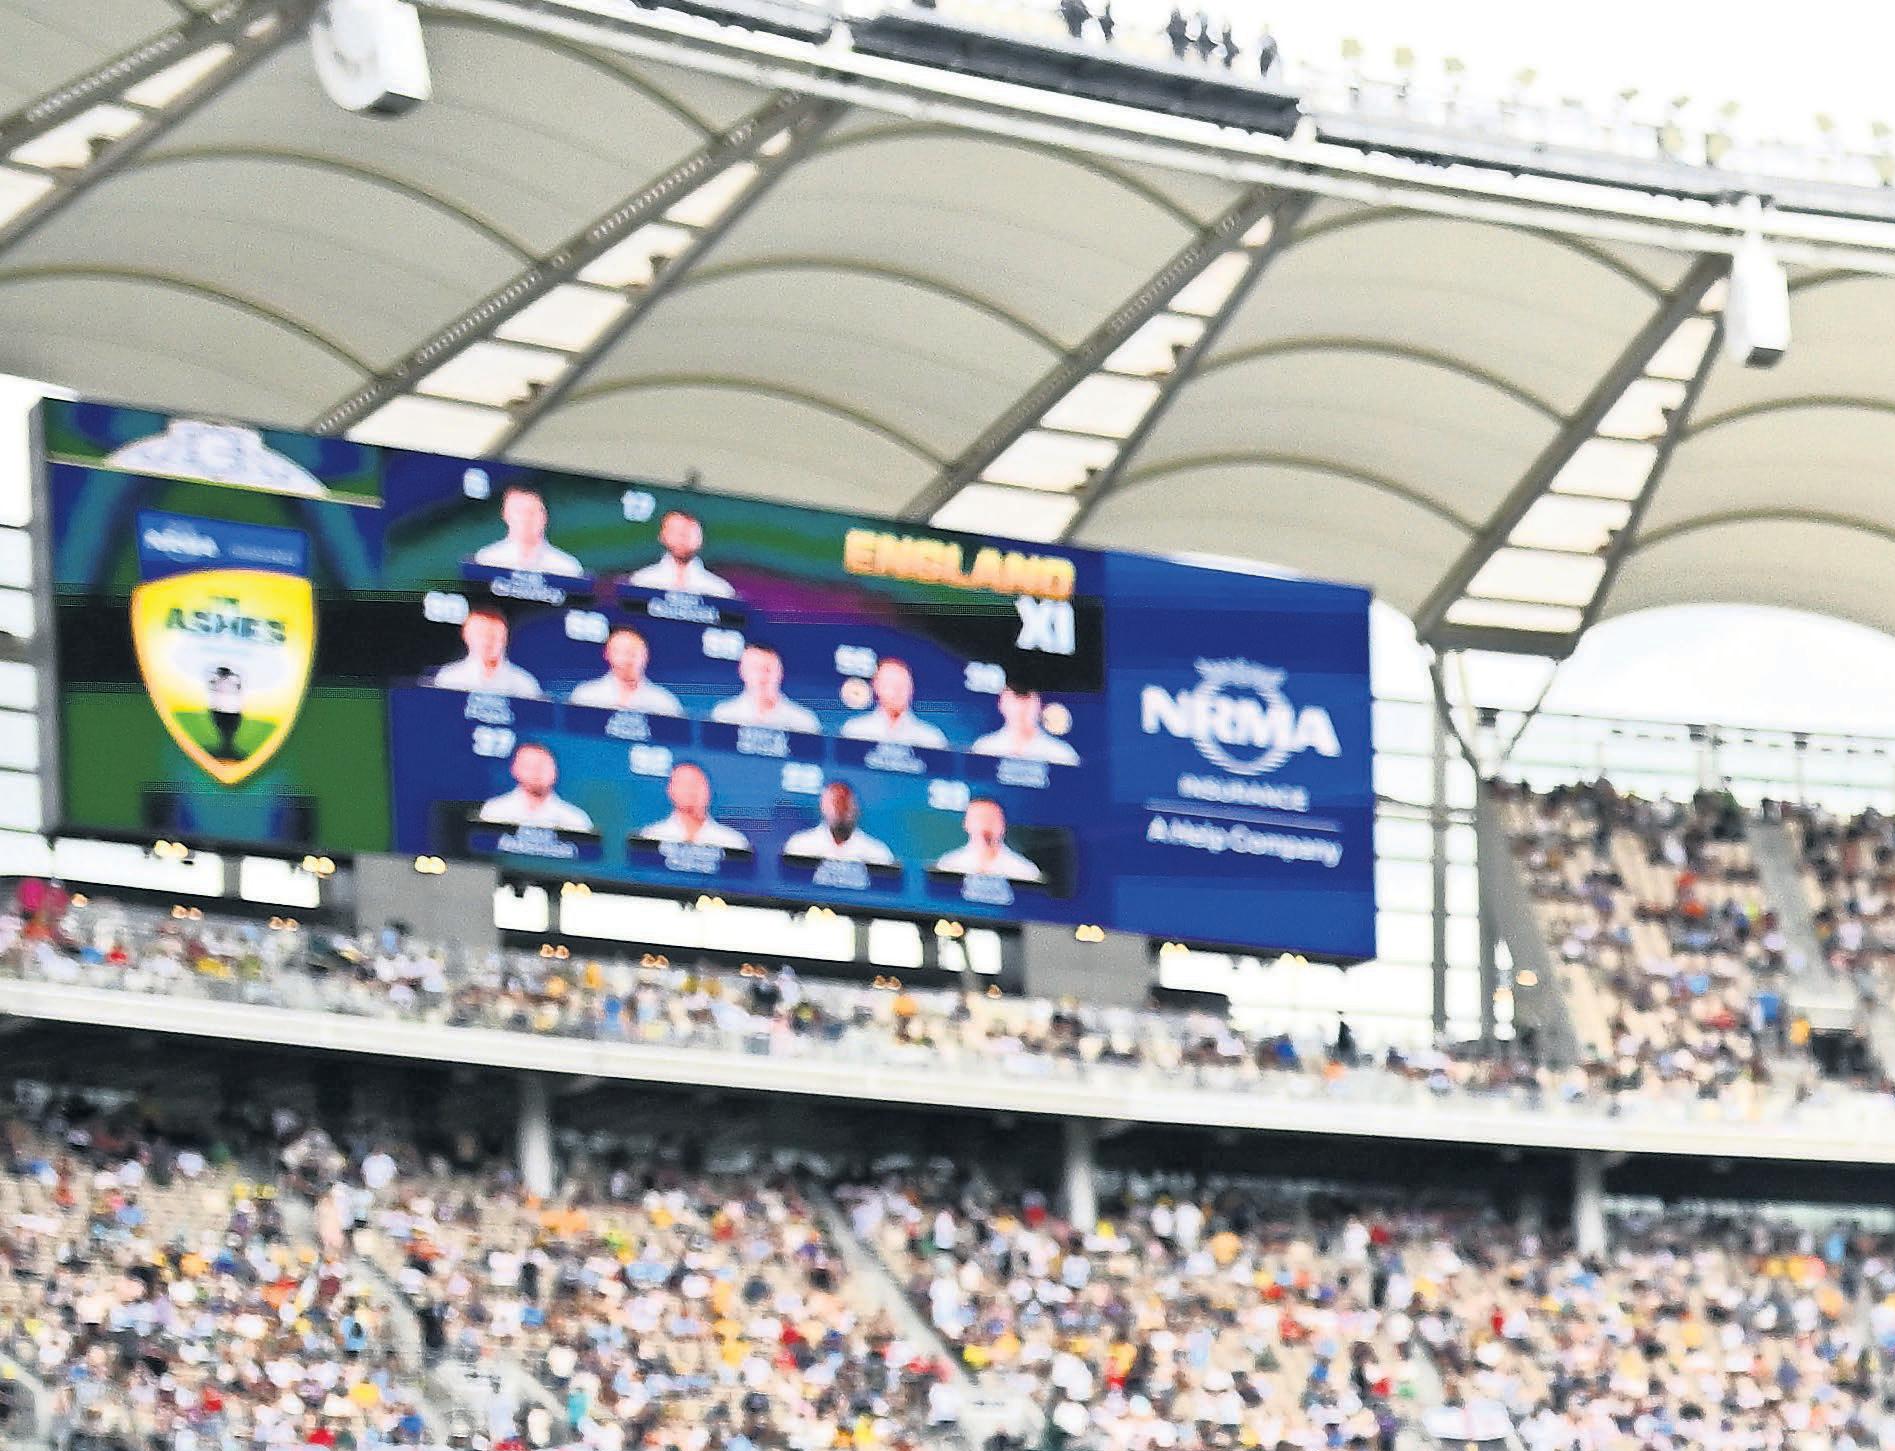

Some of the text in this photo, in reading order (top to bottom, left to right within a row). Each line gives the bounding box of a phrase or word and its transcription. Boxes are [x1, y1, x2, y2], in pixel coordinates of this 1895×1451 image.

[844, 530, 1076, 600] ENGLAND
[167, 607, 288, 643] ASHES
[1014, 595, 1075, 656] XI
[1140, 684, 1343, 758] NRMA
